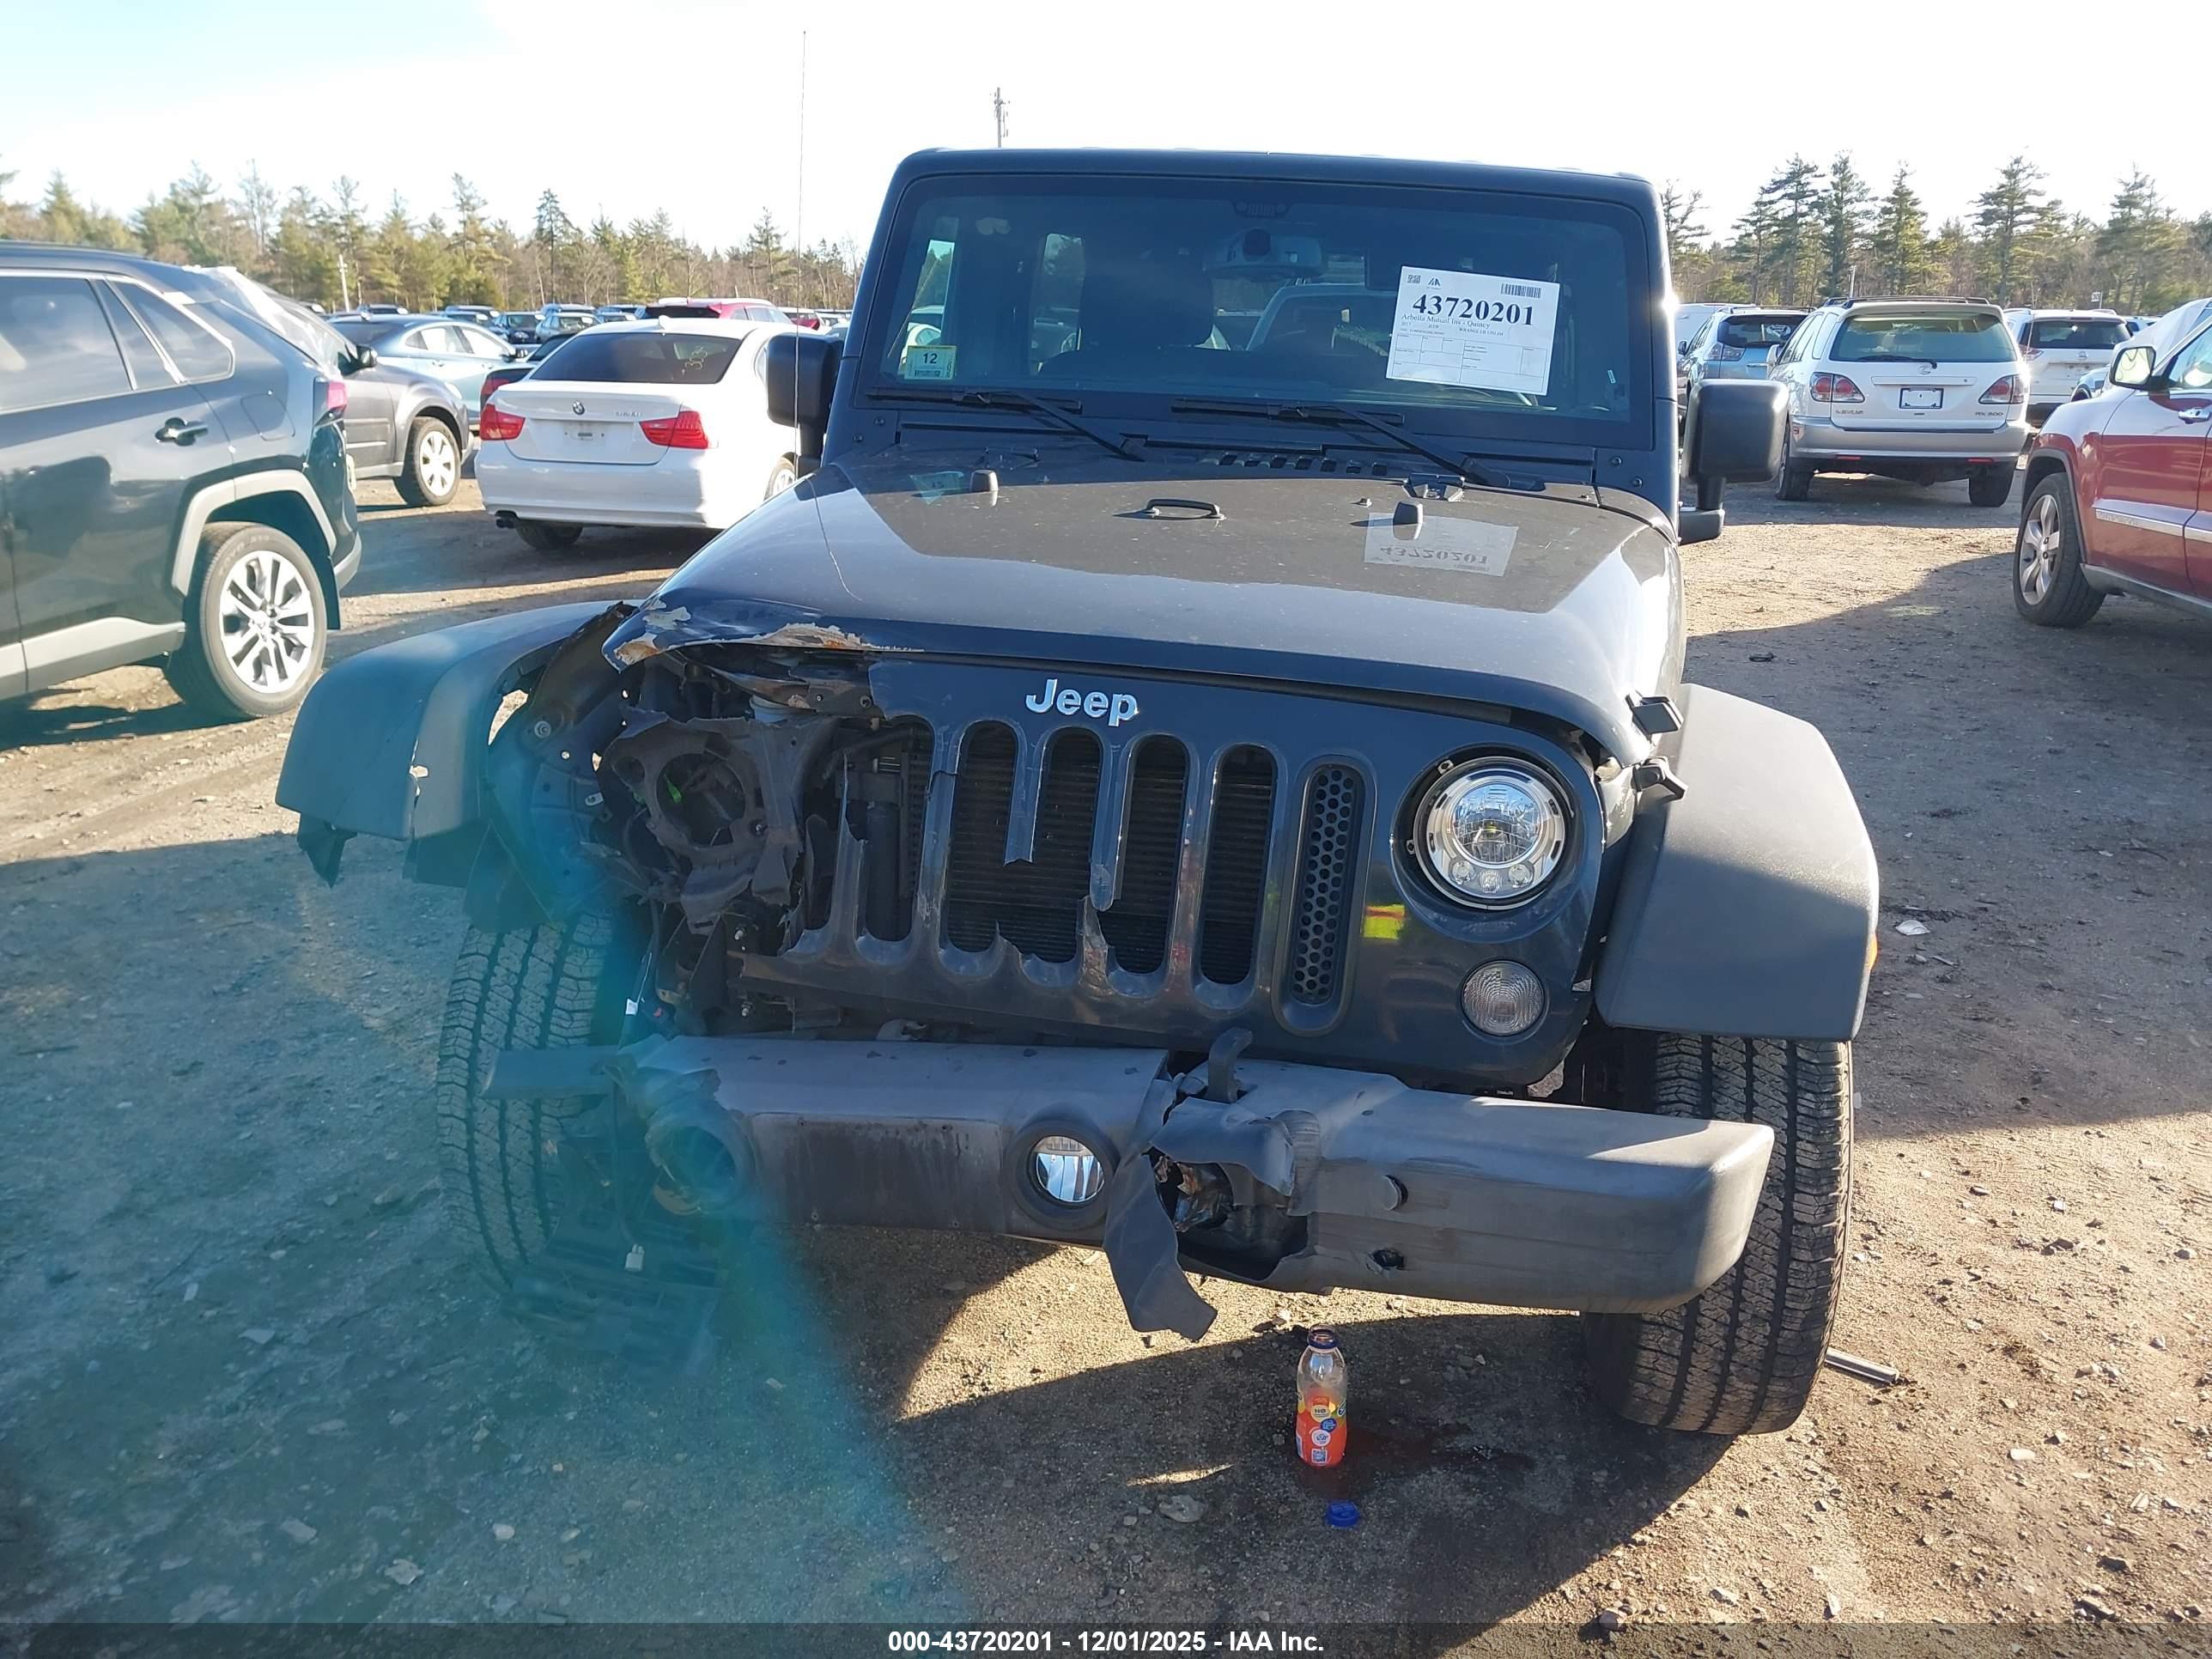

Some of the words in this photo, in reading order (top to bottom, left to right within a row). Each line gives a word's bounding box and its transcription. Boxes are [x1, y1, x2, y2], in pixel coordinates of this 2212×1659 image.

[1413, 294, 1533, 325] 43720201
[1468, 320, 1491, 329] Quincy
[923, 352, 939, 364] 12
[1025, 678, 1139, 727] Jeep
